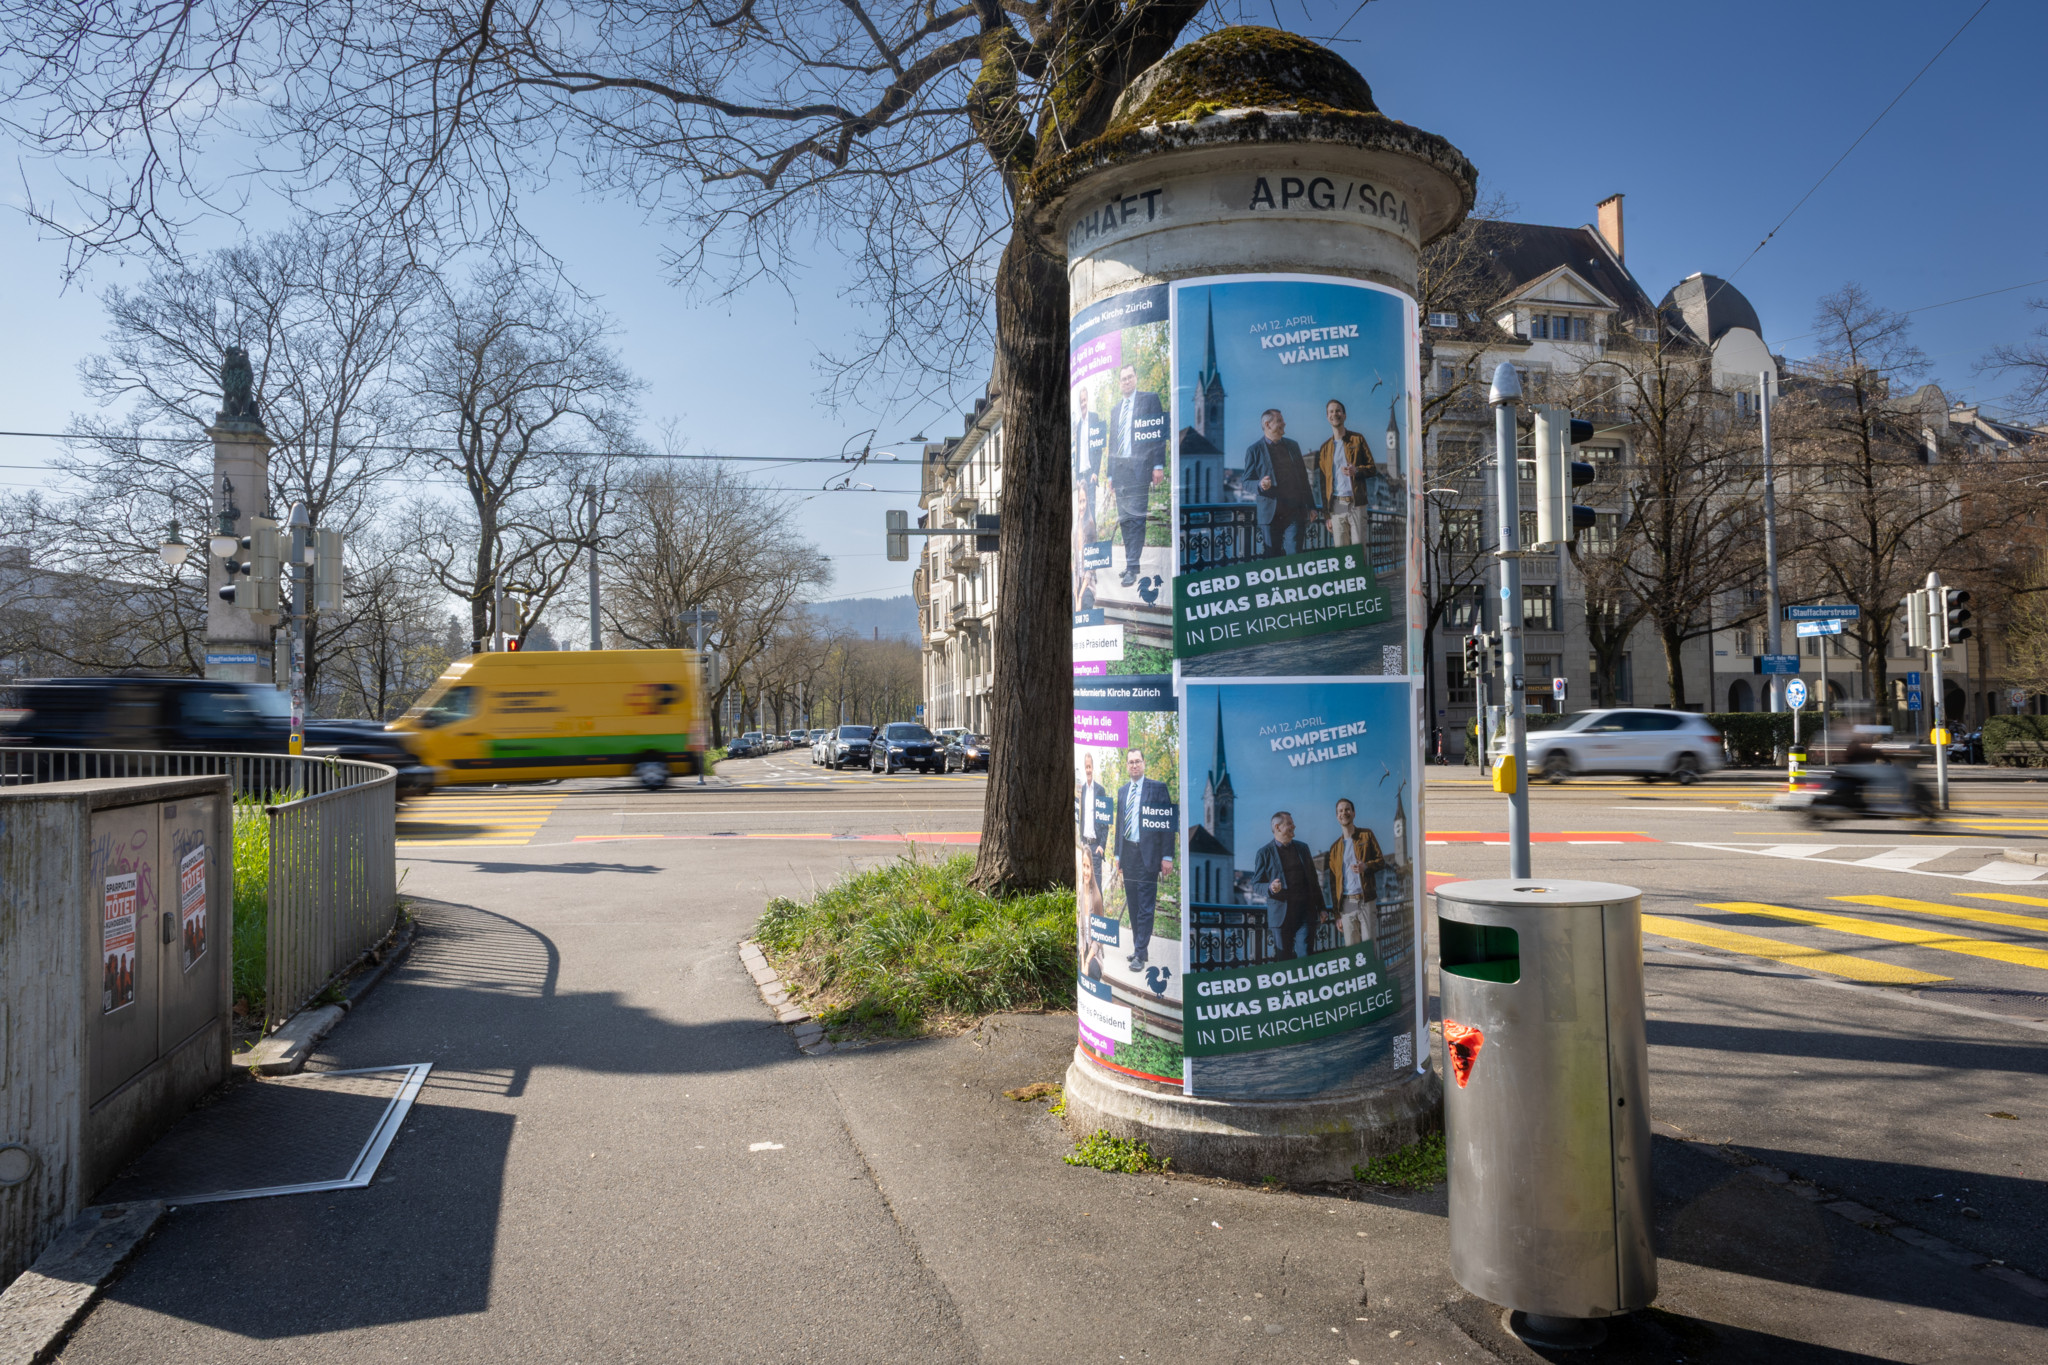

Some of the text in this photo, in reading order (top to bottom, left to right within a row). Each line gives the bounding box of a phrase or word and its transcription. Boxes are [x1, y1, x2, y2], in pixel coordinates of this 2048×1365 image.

[1249, 177, 1411, 234] APG/SGA
[1101, 308, 1124, 321] Kirche
[1125, 300, 1153, 313] Zürich
[1249, 315, 1317, 334] AM 12. APRIL
[1260, 324, 1359, 349] KOMPETENZ
[1095, 341, 1106, 353] die
[1278, 343, 1350, 365] WÄHLEN
[1089, 355, 1113, 370] wählen
[1134, 416, 1164, 429] Marcel
[1089, 427, 1100, 436] Res
[1134, 430, 1161, 441] Roost
[1089, 438, 1104, 449] Peter
[1084, 545, 1100, 556] Céline
[1083, 557, 1110, 569] Reymond
[1186, 554, 1356, 598] GERD BOLLIGER &
[1185, 576, 1367, 622] LUKAS BÄRLOCHER
[1792, 608, 1857, 617] Stauffacherstrasse
[1186, 597, 1383, 646] IN DIE KIRCHENPFLEGE
[1086, 638, 1118, 649] Präsident
[1107, 688, 1131, 697] Kirche
[1132, 687, 1161, 697] Zürich
[1100, 716, 1112, 726] die
[1259, 716, 1326, 737] AM 12. APRIL
[1093, 730, 1119, 741] wählen
[1270, 720, 1367, 752] KOMPETENZ
[1287, 741, 1358, 768] WÄHLEN
[1095, 799, 1107, 808] Res
[1095, 811, 1111, 822] Peter
[1142, 806, 1173, 817] Marcel
[1142, 818, 1170, 829] Roost
[106, 879, 136, 894] SPARPOLITIK
[105, 894, 136, 918] TÖTET
[1091, 917, 1107, 930] Céline
[1091, 930, 1118, 945] Reymond
[1196, 952, 1367, 998] GERD BOLLIGER &
[1196, 972, 1378, 1021] LUKAS BÄRLOCHER
[1093, 1009, 1126, 1030] Präsident
[1197, 989, 1393, 1046] IN DIE KIRCHENPFLEGE
